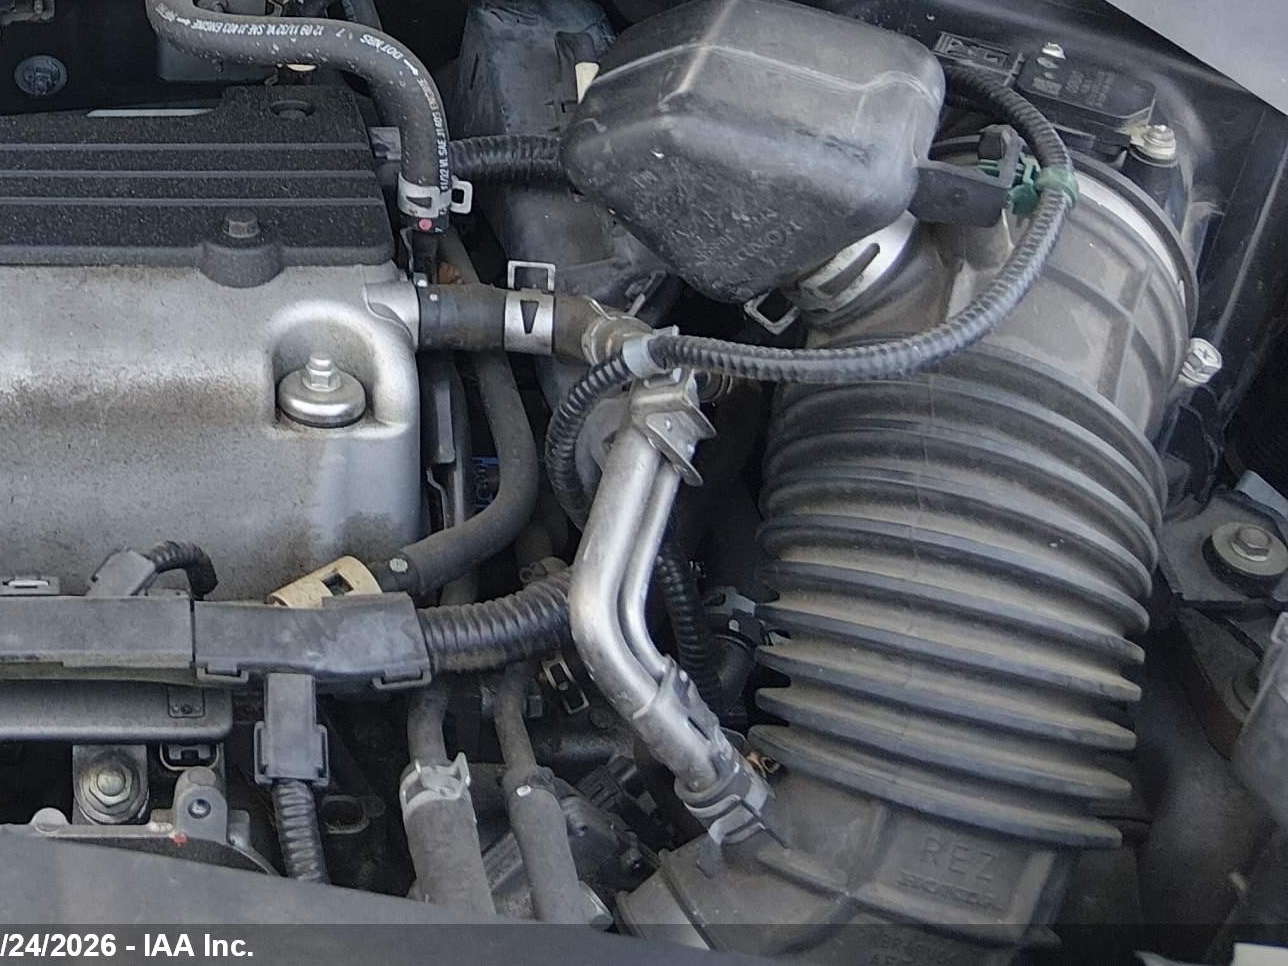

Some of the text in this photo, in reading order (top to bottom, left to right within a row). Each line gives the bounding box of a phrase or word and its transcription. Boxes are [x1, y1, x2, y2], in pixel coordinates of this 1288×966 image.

[380, 42, 404, 59] DOT
[416, 78, 439, 111] ENGINE
[436, 138, 448, 156] SAE
